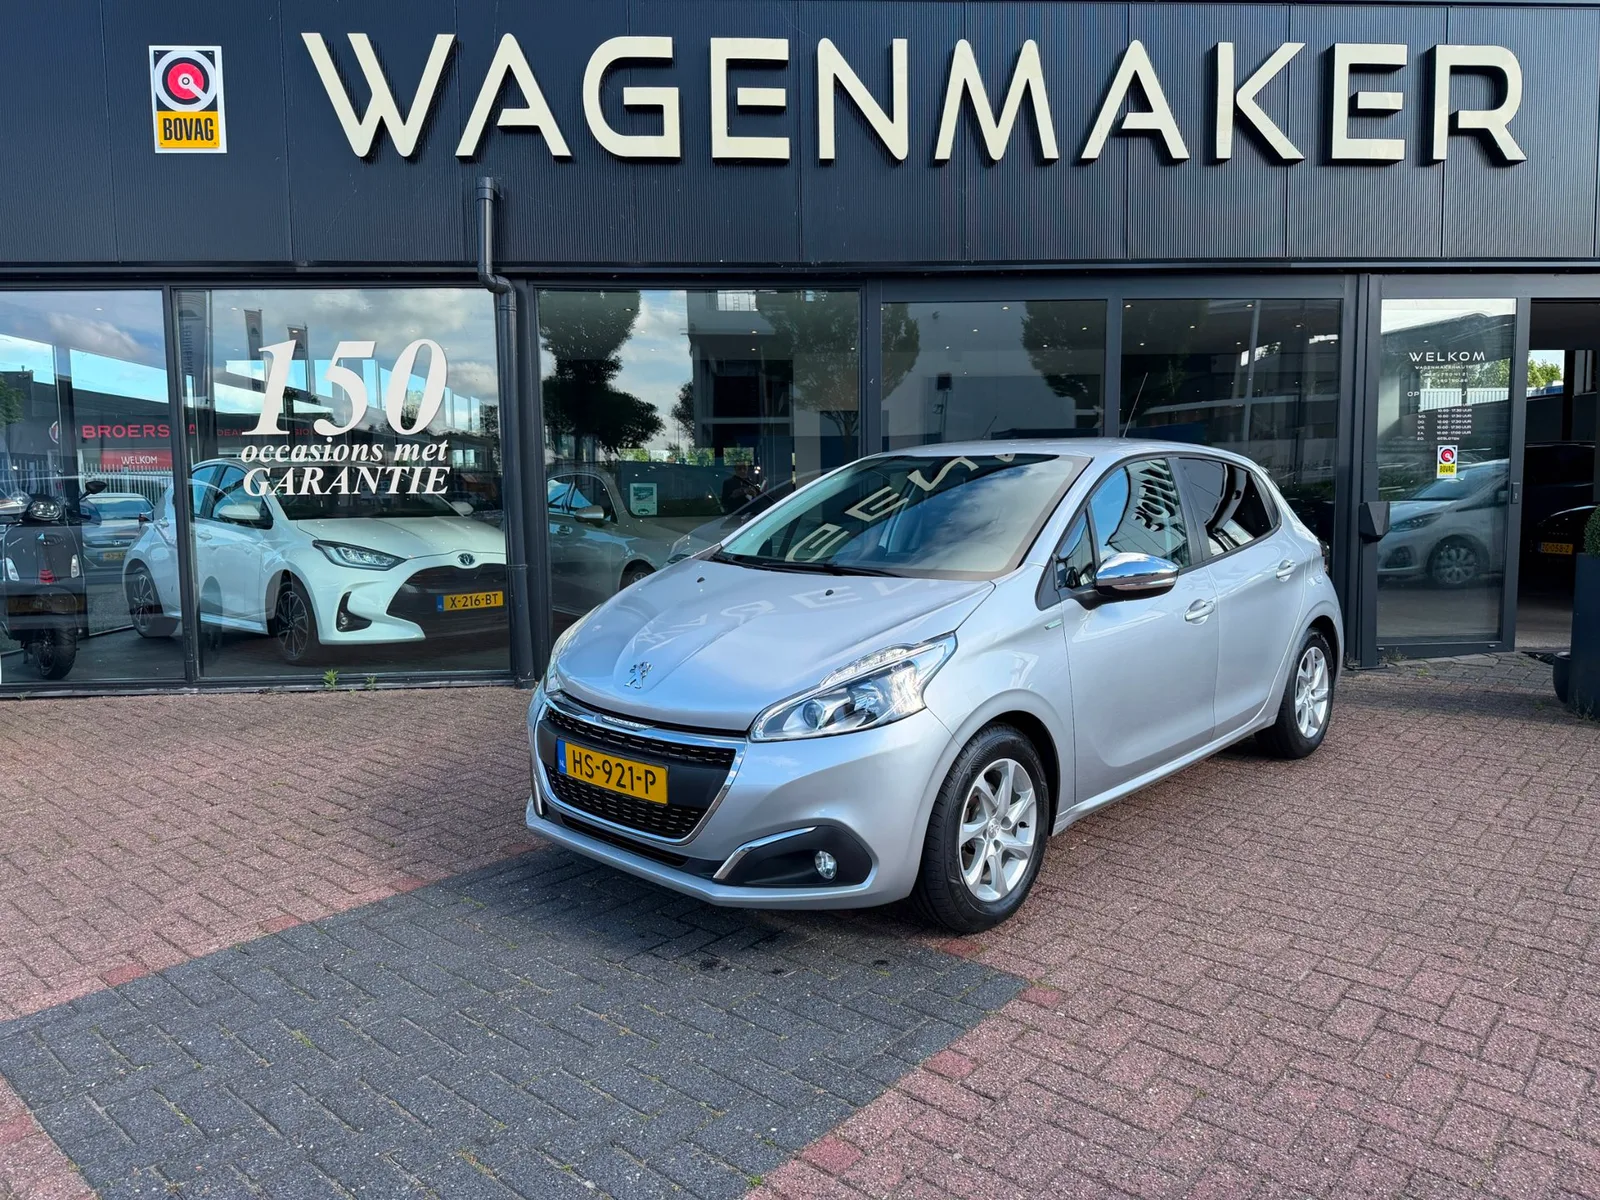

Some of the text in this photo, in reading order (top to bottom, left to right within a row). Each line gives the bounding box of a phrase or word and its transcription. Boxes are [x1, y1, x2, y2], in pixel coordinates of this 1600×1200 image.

[301, 32, 1526, 162] WAGENMAKER
[163, 118, 214, 142] BOVAG
[1408, 351, 1485, 363] WELKOM
[241, 339, 448, 436] 150
[121, 455, 157, 465] WELKOM
[241, 437, 448, 463] occasions met
[243, 466, 451, 497] GARANTIE
[1440, 465, 1454, 473] BOVAG
[450, 593, 498, 609] X-216-BT
[572, 749, 656, 795] HS-921-P
